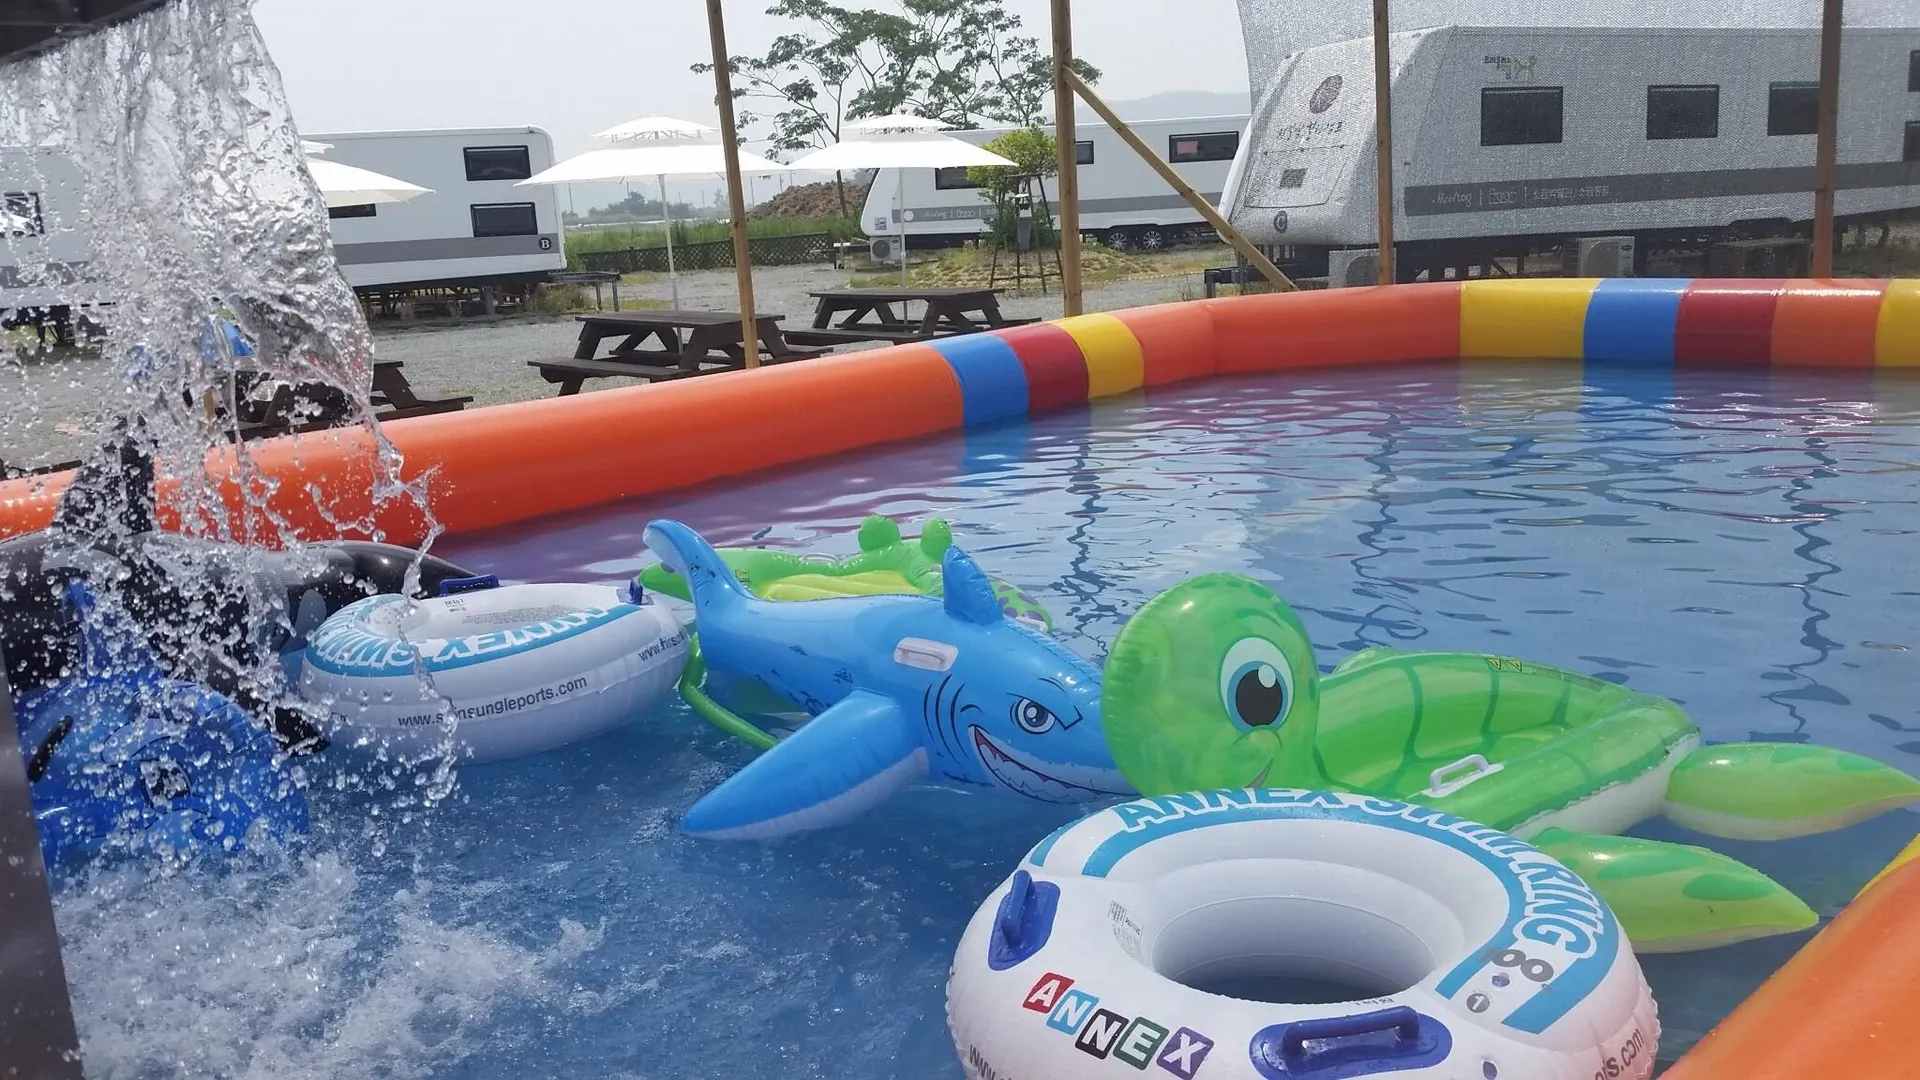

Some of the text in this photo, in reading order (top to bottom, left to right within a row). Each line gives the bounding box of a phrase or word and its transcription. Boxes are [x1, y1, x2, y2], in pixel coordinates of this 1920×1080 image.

[1276, 214, 1287, 230] C
[540, 239, 550, 249] B
[1026, 977, 1209, 1076] ANNEX
